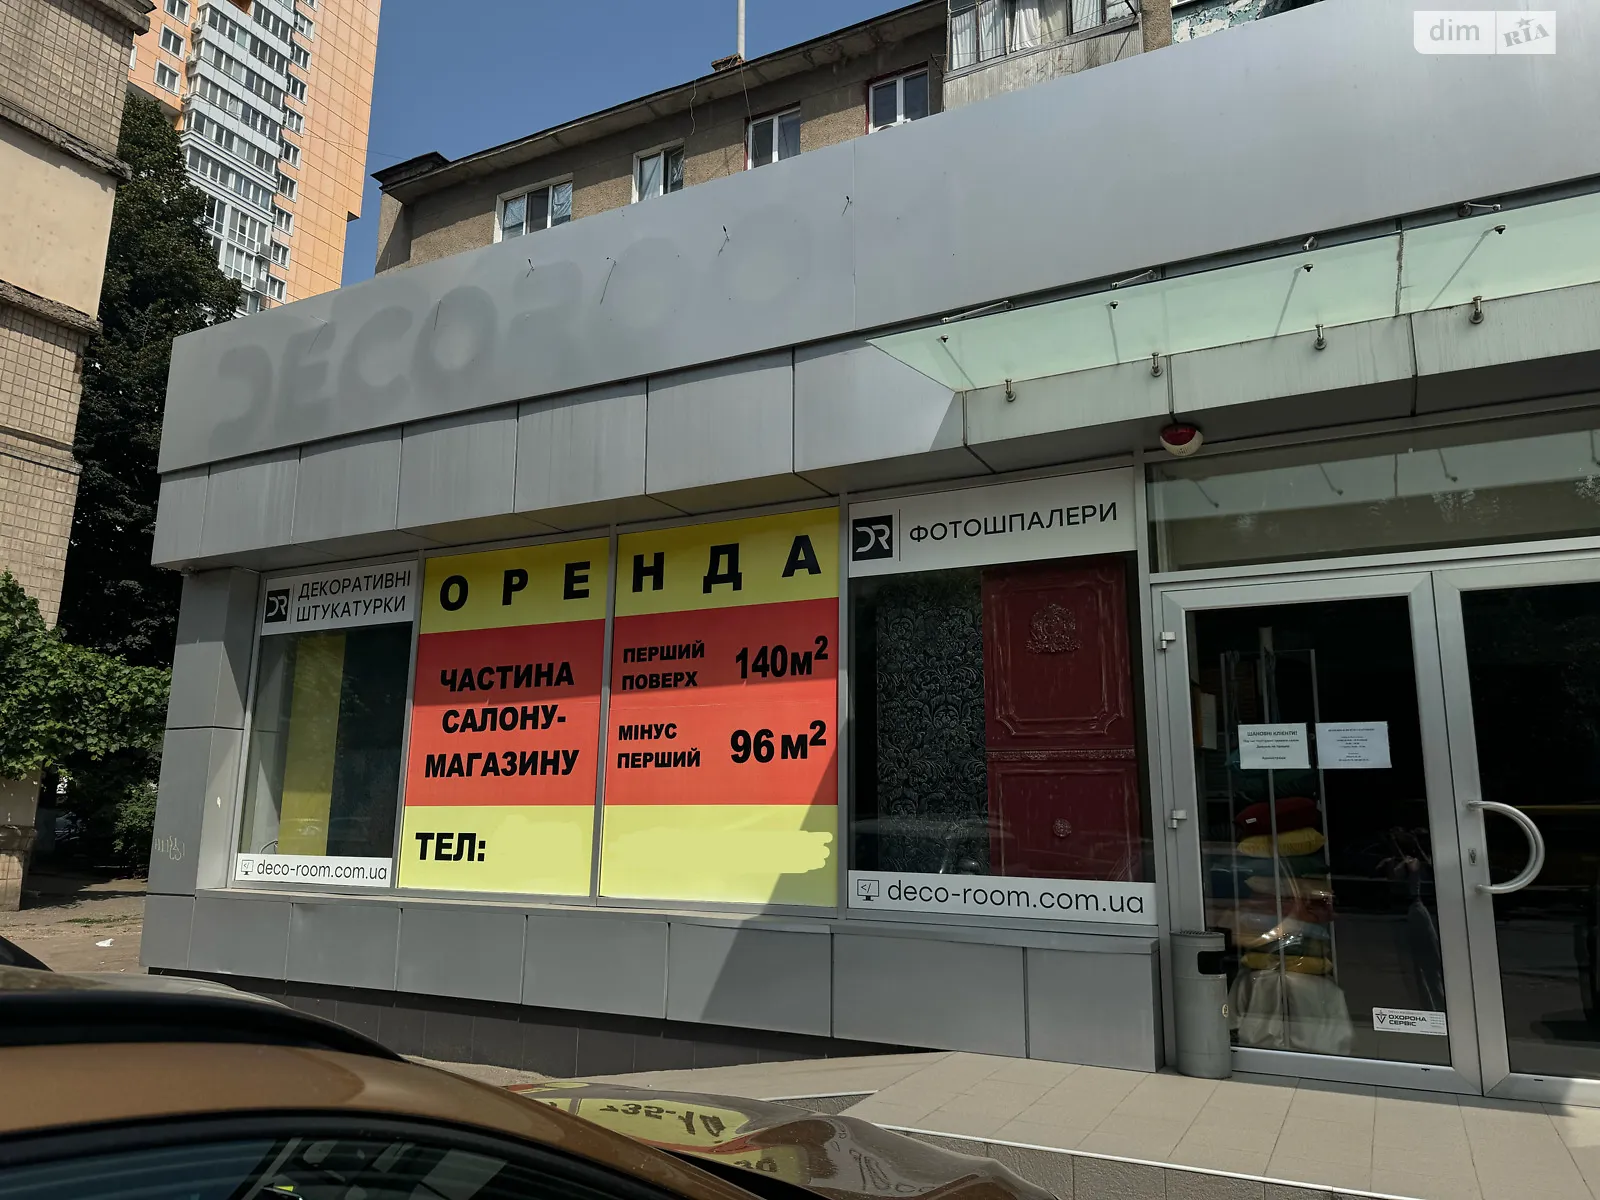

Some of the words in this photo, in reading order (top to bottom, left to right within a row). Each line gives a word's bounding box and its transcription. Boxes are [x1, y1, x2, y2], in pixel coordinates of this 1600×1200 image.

[909, 502, 1117, 543] ФОТОШПАЛЕРИ
[298, 570, 411, 601] ДЕКОРАТИВНІ
[296, 595, 406, 623] ШТУКАТУРКИ
[623, 640, 705, 664] ПЕРШИЙ
[440, 661, 575, 692] ЧАСТИНА
[622, 671, 698, 690] ПОВЕРХ
[442, 704, 567, 734] САЛОНУ-
[618, 723, 678, 741] МІНУС
[424, 749, 580, 778] МАГАЗИНУ
[617, 747, 701, 768] ПЕРШИЙ
[415, 832, 487, 862] ТЕЛ:
[257, 859, 388, 880] deco-room.com.ua
[887, 879, 1144, 914] deco-room.com.ua
[1388, 1014, 1427, 1022] ОХОРОНА
